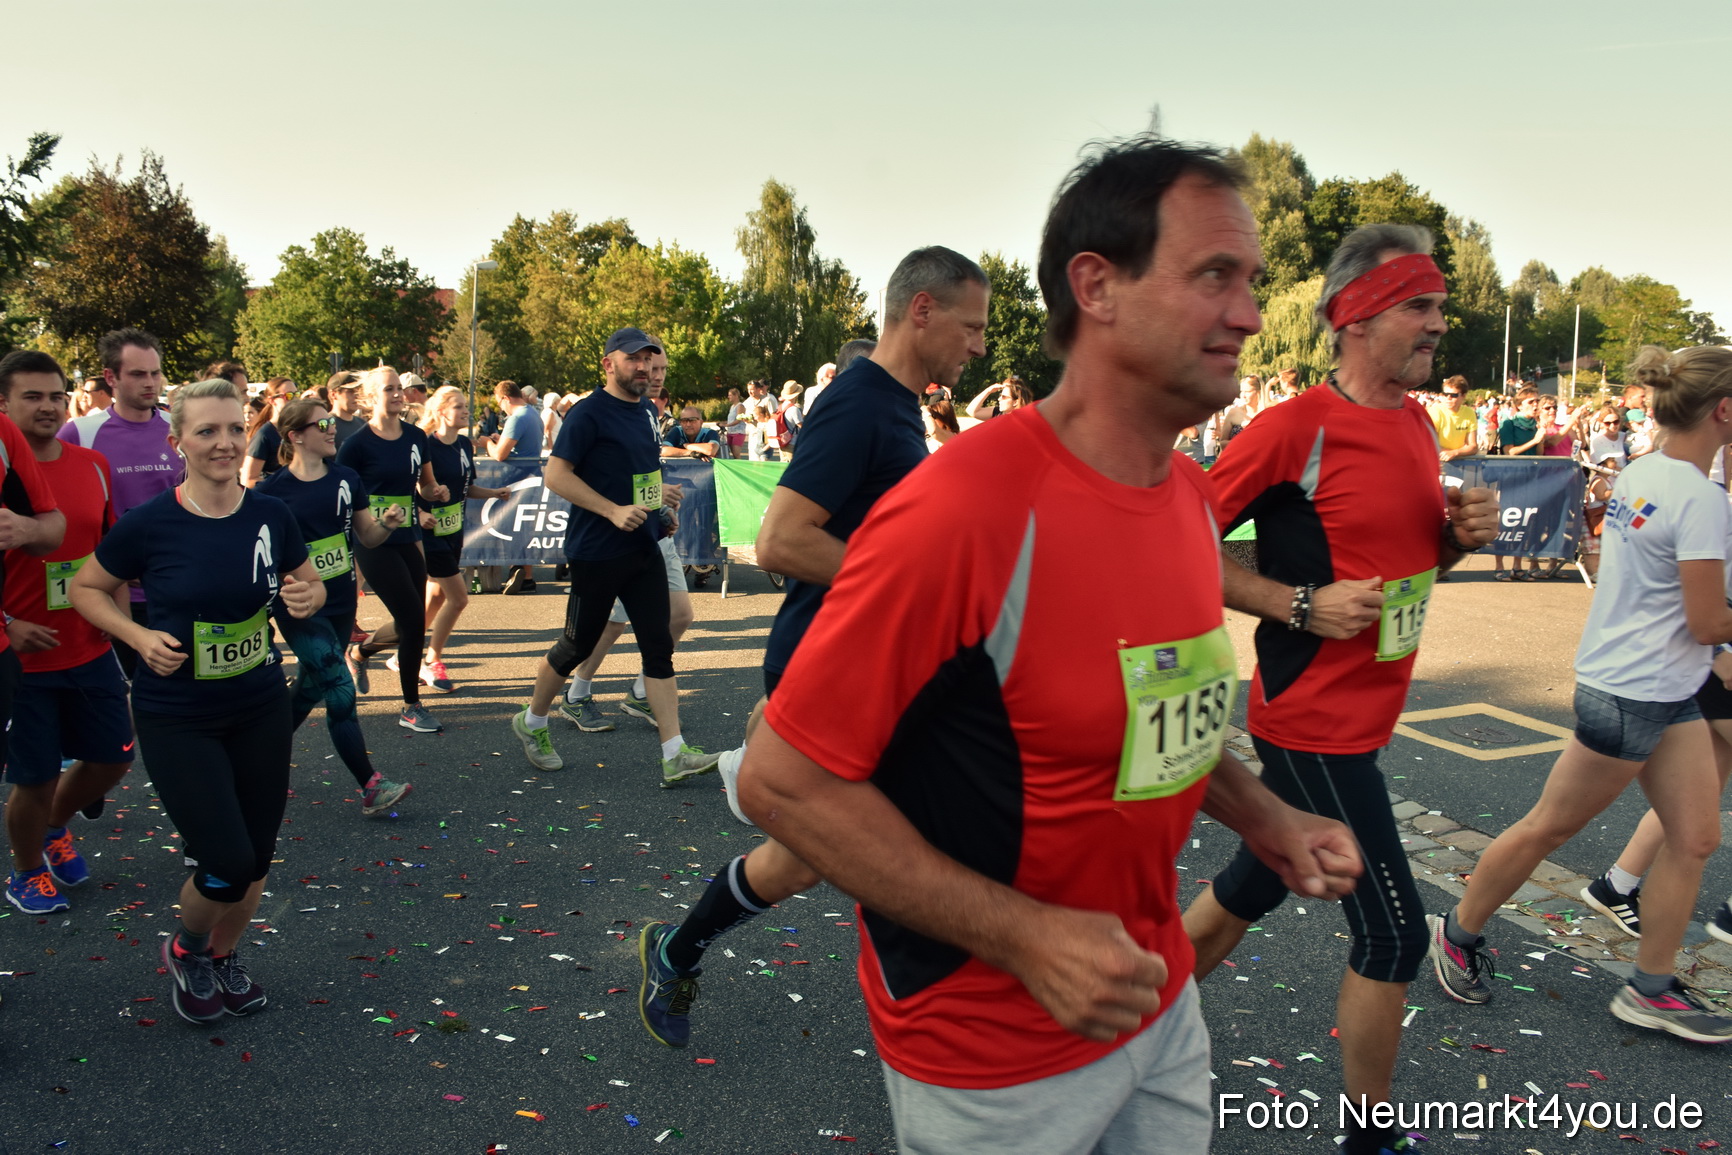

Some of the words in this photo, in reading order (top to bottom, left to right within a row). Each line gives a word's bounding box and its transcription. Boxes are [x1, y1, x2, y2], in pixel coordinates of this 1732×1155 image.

[116, 466, 133, 474] WIR
[438, 513, 460, 528] 1607
[512, 503, 568, 532] Fis
[1500, 506, 1538, 527] er
[527, 537, 565, 549] AUT
[313, 548, 344, 569] 604
[1393, 599, 1428, 636] 115
[206, 631, 262, 664] 1608
[1149, 681, 1227, 753] 1158
